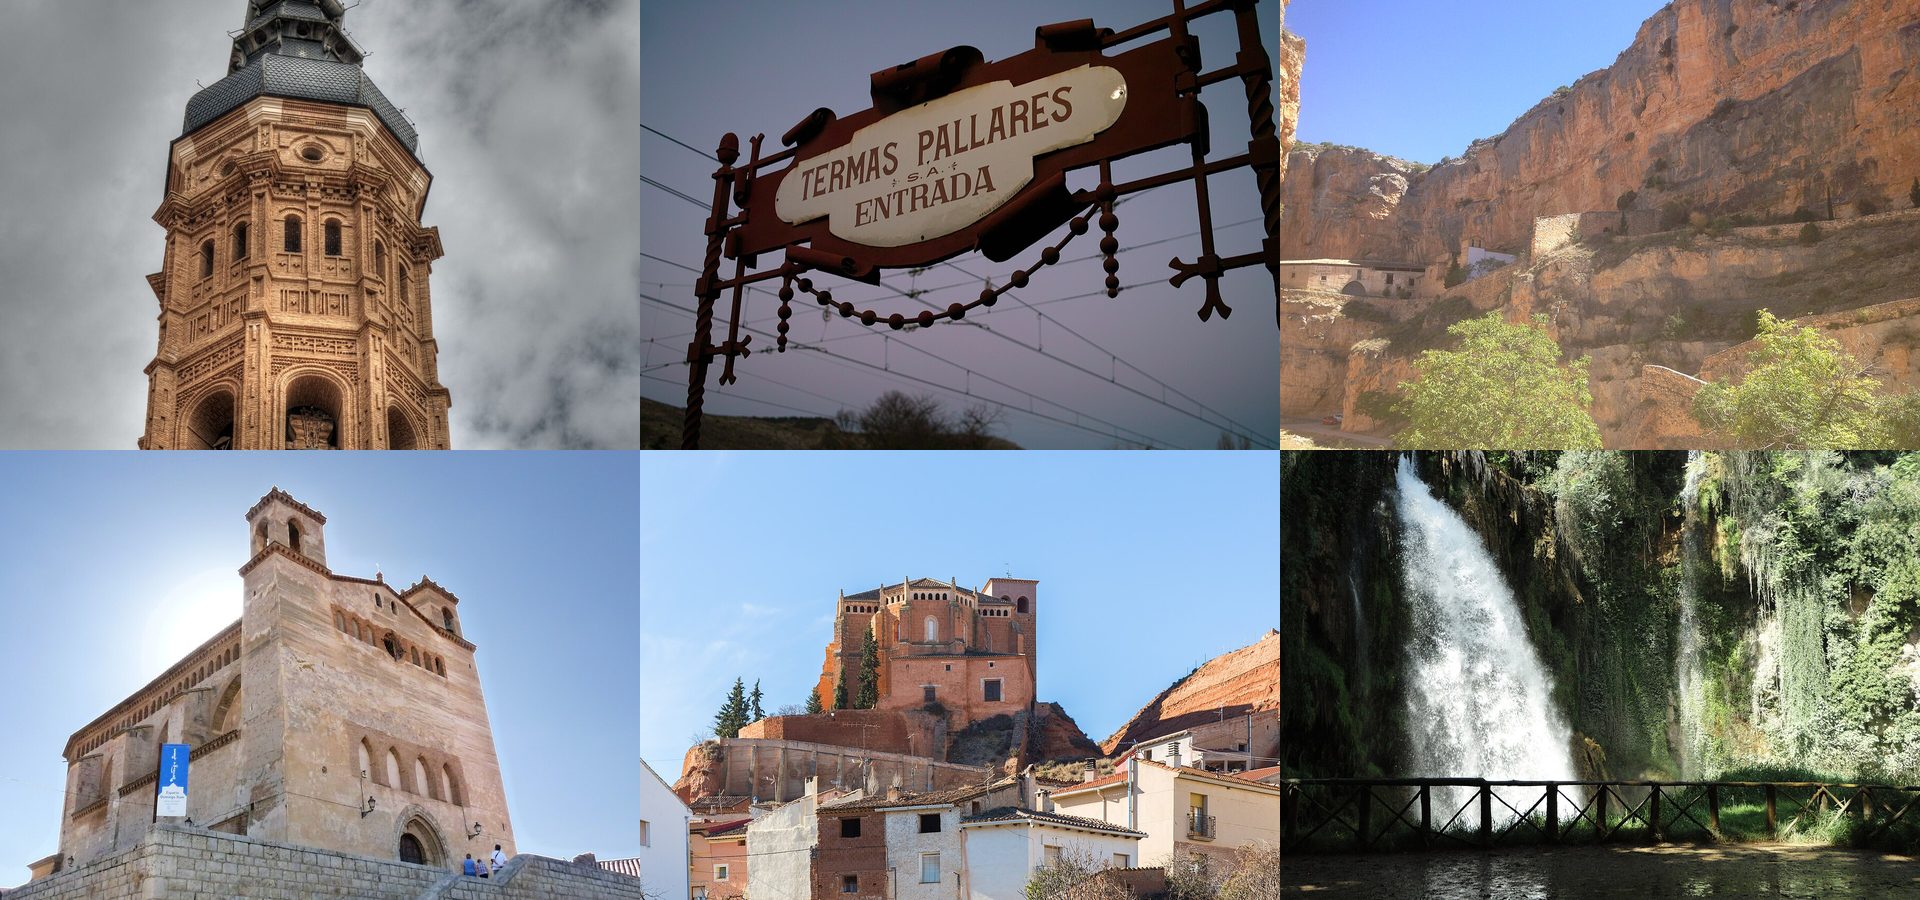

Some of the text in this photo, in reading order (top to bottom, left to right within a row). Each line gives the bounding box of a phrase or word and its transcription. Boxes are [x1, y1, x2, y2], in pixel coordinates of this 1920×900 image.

[802, 142, 899, 201] TERMAS
[917, 86, 1073, 166] PALLARES
[907, 165, 945, 183] S.A.
[855, 166, 996, 227] ENTRADA
